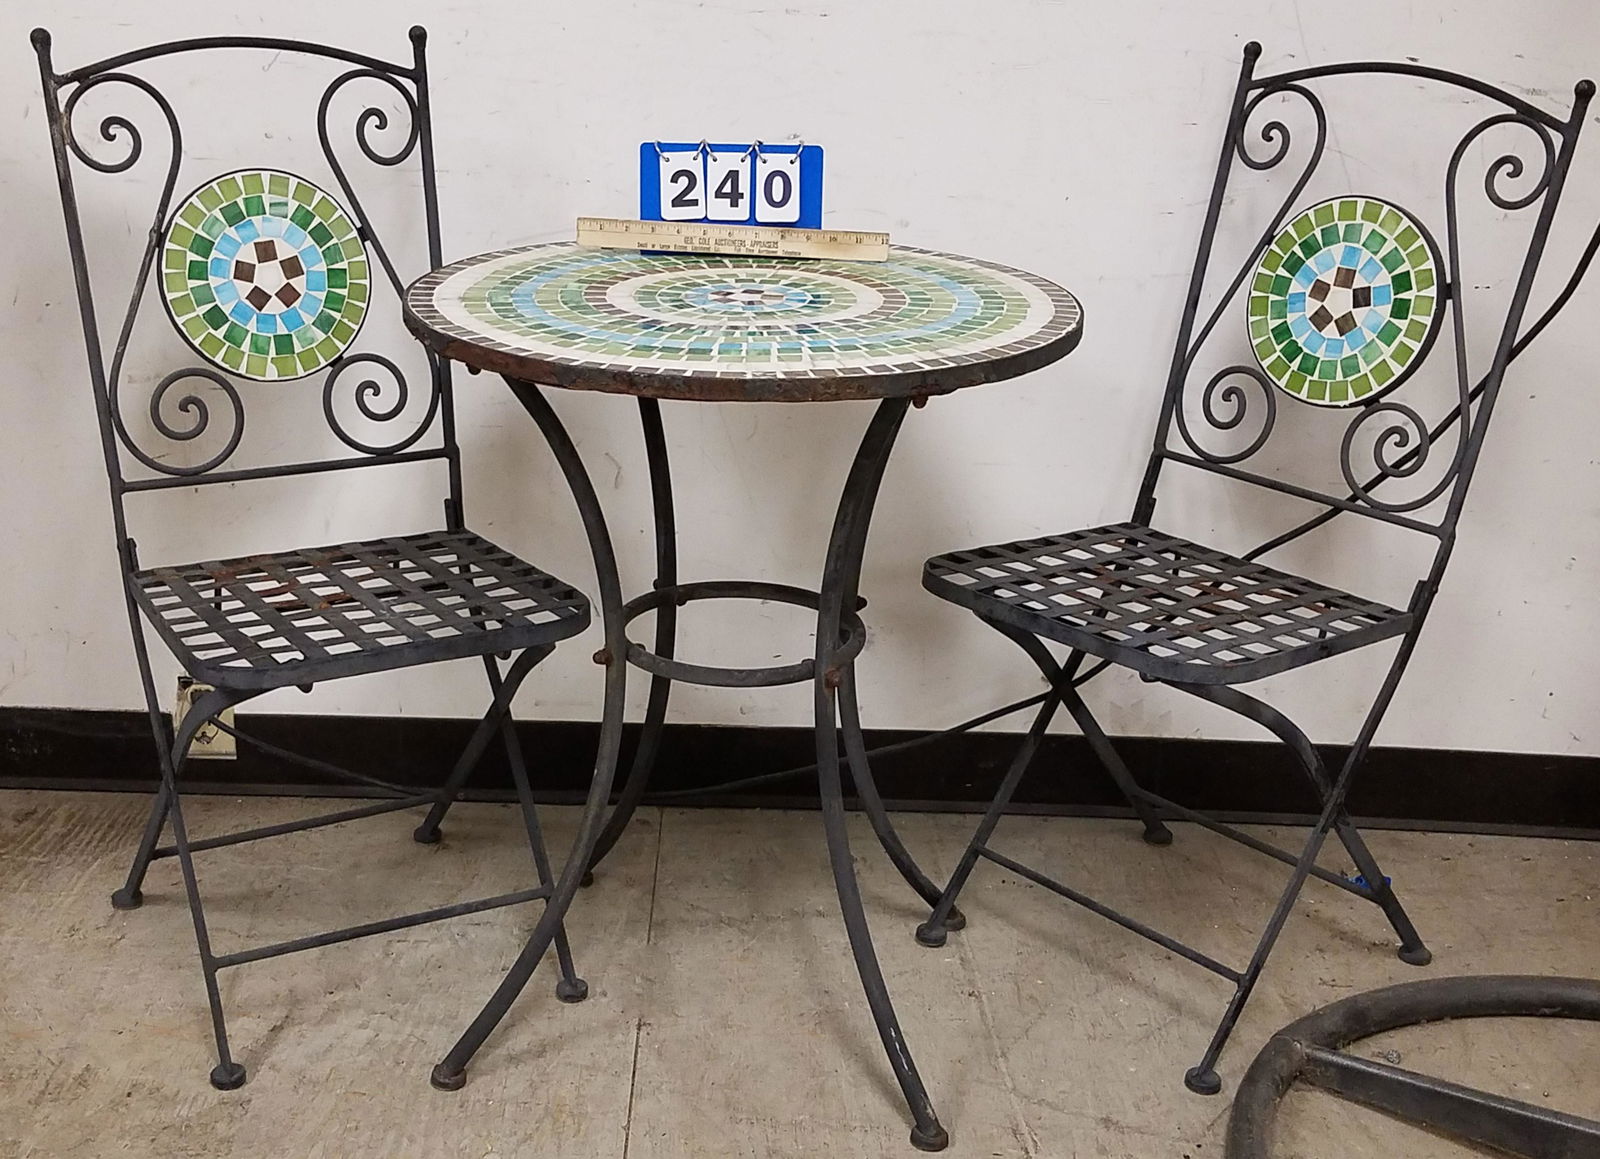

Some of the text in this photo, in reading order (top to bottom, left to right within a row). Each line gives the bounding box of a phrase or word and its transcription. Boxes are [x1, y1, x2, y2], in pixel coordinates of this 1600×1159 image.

[670, 169, 792, 208] 240
[699, 237, 711, 246] COLE
[829, 235, 837, 243] 10
[855, 236, 862, 244] 11
